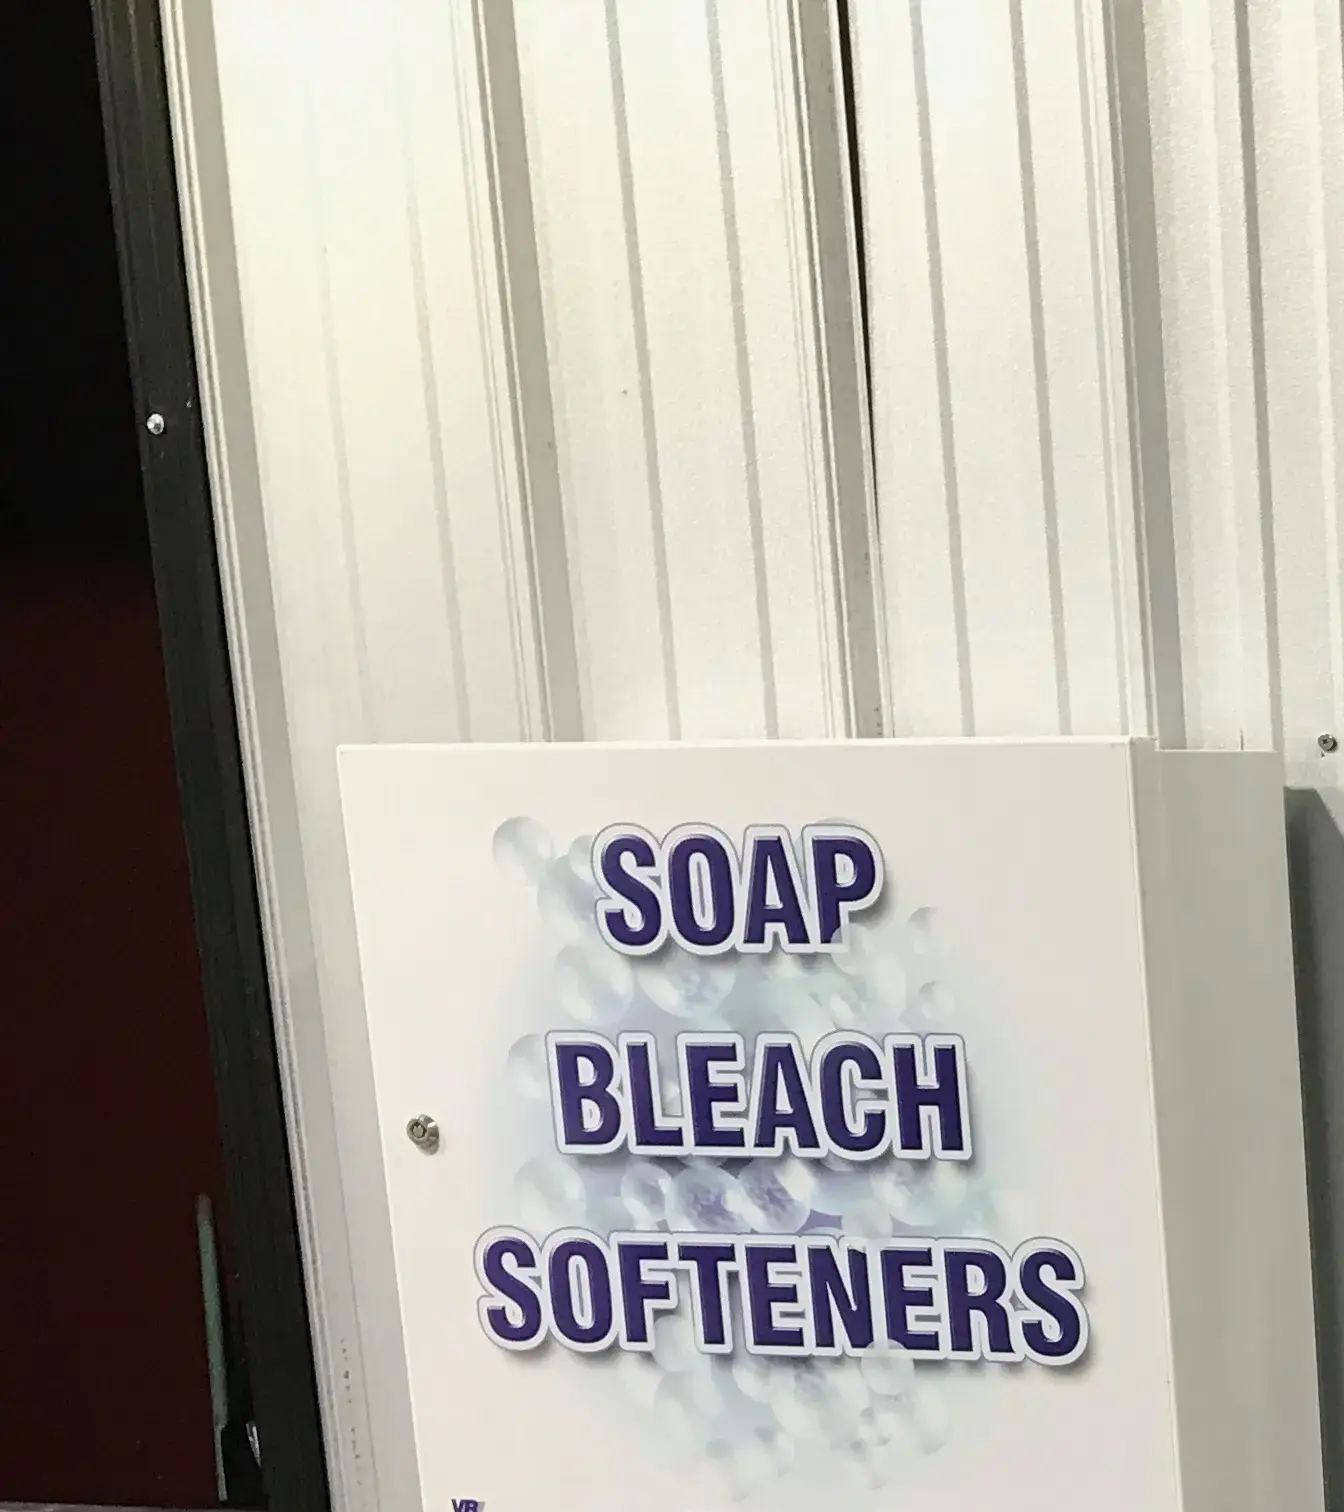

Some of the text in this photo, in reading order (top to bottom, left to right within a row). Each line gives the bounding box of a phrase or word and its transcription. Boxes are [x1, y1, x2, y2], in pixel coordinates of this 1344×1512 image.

[594, 826, 882, 952] SOAP
[549, 1034, 968, 1157] BLEACH
[478, 1230, 1086, 1362] SOFTENERS
